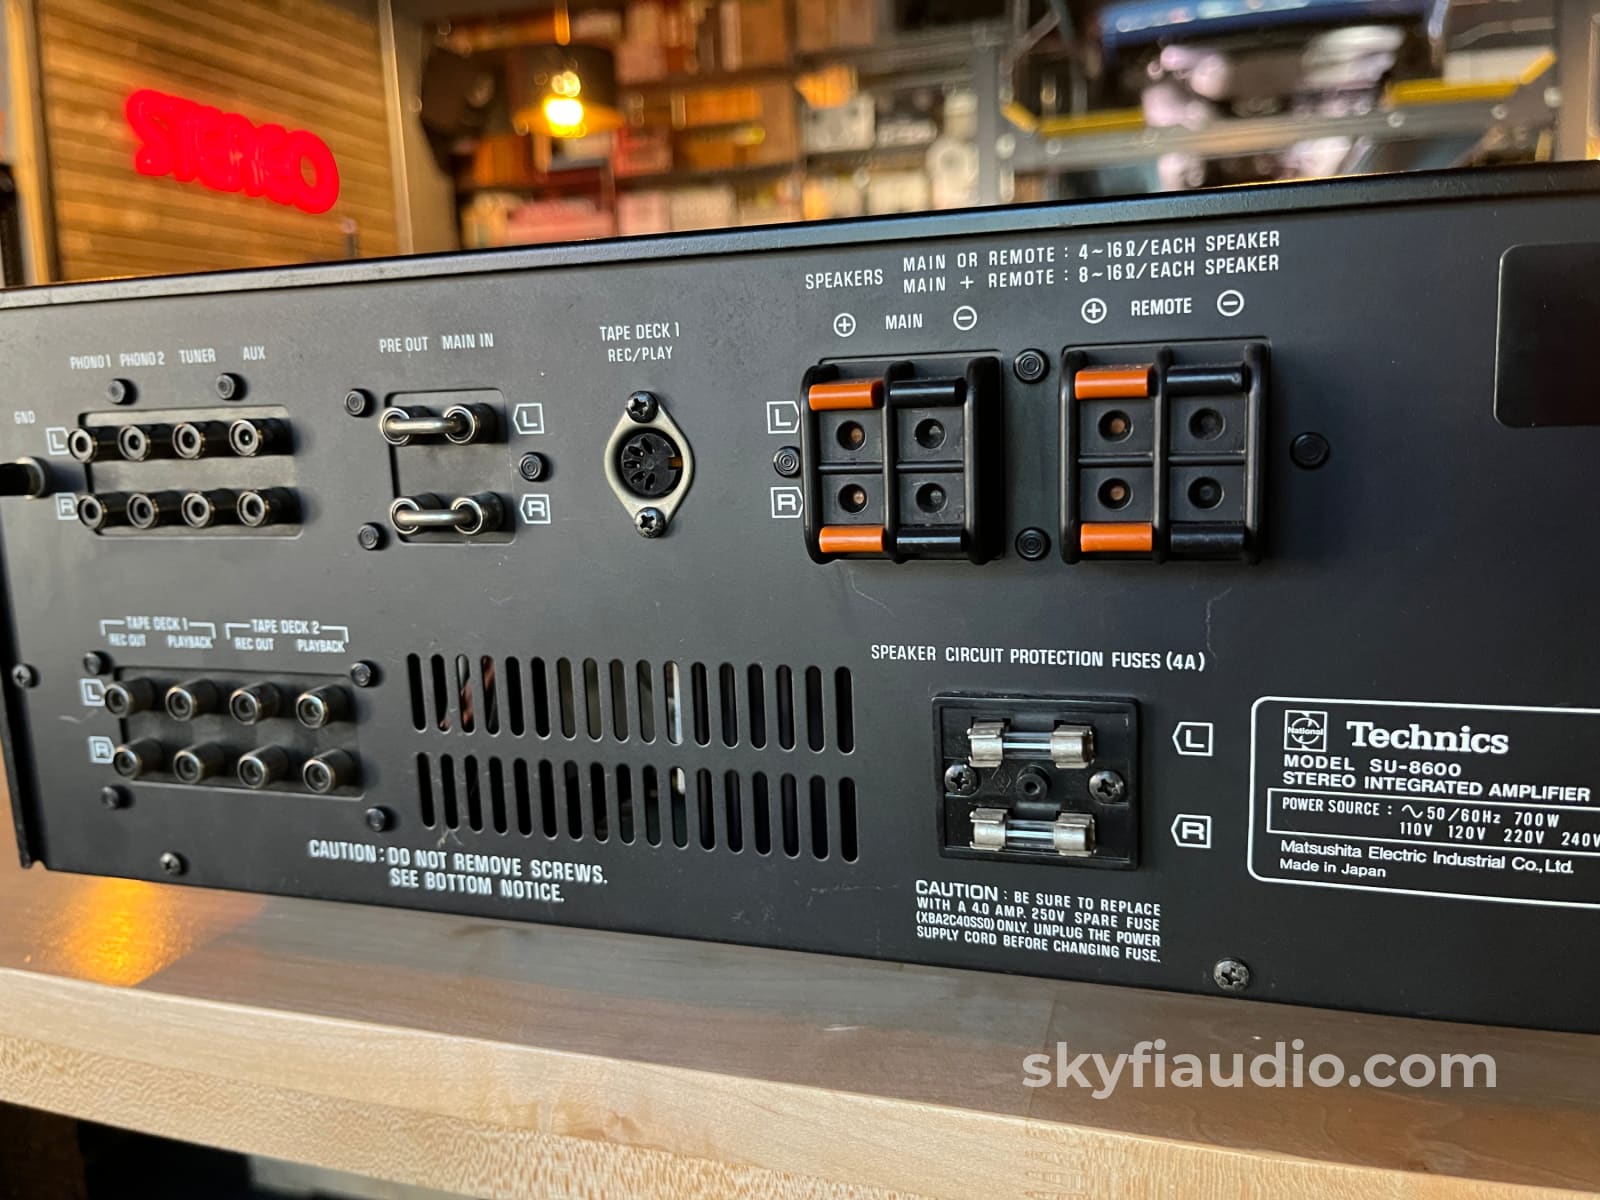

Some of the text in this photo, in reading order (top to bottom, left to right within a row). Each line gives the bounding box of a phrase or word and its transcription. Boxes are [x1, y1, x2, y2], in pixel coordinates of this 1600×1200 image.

[903, 254, 946, 273] MAIN
[957, 252, 978, 268] OR
[989, 247, 1055, 266] REMOTE
[1206, 230, 1279, 252] SPEAKER
[805, 269, 884, 289] SPEAKERS
[903, 276, 946, 293] MAIN
[989, 269, 1054, 288] REMOTE
[1205, 254, 1279, 275] SPEAKER
[1131, 297, 1192, 316] REMOTE
[885, 313, 923, 330] MAIN
[442, 333, 495, 349] MAIN IN
[600, 322, 680, 342] TAPE DECK 1
[243, 346, 266, 361] AUX
[379, 337, 428, 353] PRE OUT
[608, 346, 673, 362] REC/PLAY
[179, 348, 216, 364] TUNER
[14, 411, 36, 424] GND
[126, 616, 150, 631] TAPE
[153, 617, 178, 631] DECK
[252, 619, 320, 634] TAPE DECK 2
[109, 634, 146, 647] REC OUT
[167, 635, 213, 649] PLAYBACK
[235, 637, 274, 651] REC OUT
[297, 639, 346, 653] PLAYBACK
[871, 645, 1205, 672] SPEAKER CIRCUIT PROTECTION FUSES (4A)
[1287, 726, 1324, 736] National
[1346, 720, 1509, 754] Technics
[1284, 754, 1461, 777] MODEL SU-8600
[1283, 771, 1591, 802] STEREO INTEGRATED AMPLIFIER
[1282, 797, 1323, 812] POWER
[1400, 822, 1432, 837] 110V
[1448, 825, 1486, 840] 120V
[1504, 828, 1544, 844] 220V
[1281, 839, 1362, 858] Matsushita
[1369, 846, 1427, 863] Electric
[1433, 851, 1505, 869] Industrial
[389, 847, 410, 866] DO
[415, 849, 447, 869] NOT
[453, 852, 521, 876] REMOVE
[530, 859, 608, 884] SCREWS.
[1280, 858, 1386, 878] Made in Japan
[390, 868, 565, 903] SEE BOTTOM NOTICE.
[1014, 891, 1029, 904] BE
[1035, 893, 1071, 908] SURE
[1078, 897, 1094, 910] TO
[1100, 899, 1160, 916] REPLACE
[917, 898, 950, 911] WITH
[958, 900, 966, 912] A
[995, 905, 1026, 918] AMP.
[1031, 908, 1064, 922] 250V
[1074, 912, 1118, 928] SPARE
[1126, 916, 1160, 931] FUSE
[997, 921, 1029, 935] ONLY.
[1034, 923, 1083, 939] UNPLUG
[1088, 928, 1110, 942] THE
[1117, 931, 1160, 947] POWER
[917, 927, 1161, 963] SUPPLY CORD BEFORE CHANGING FUSE.
